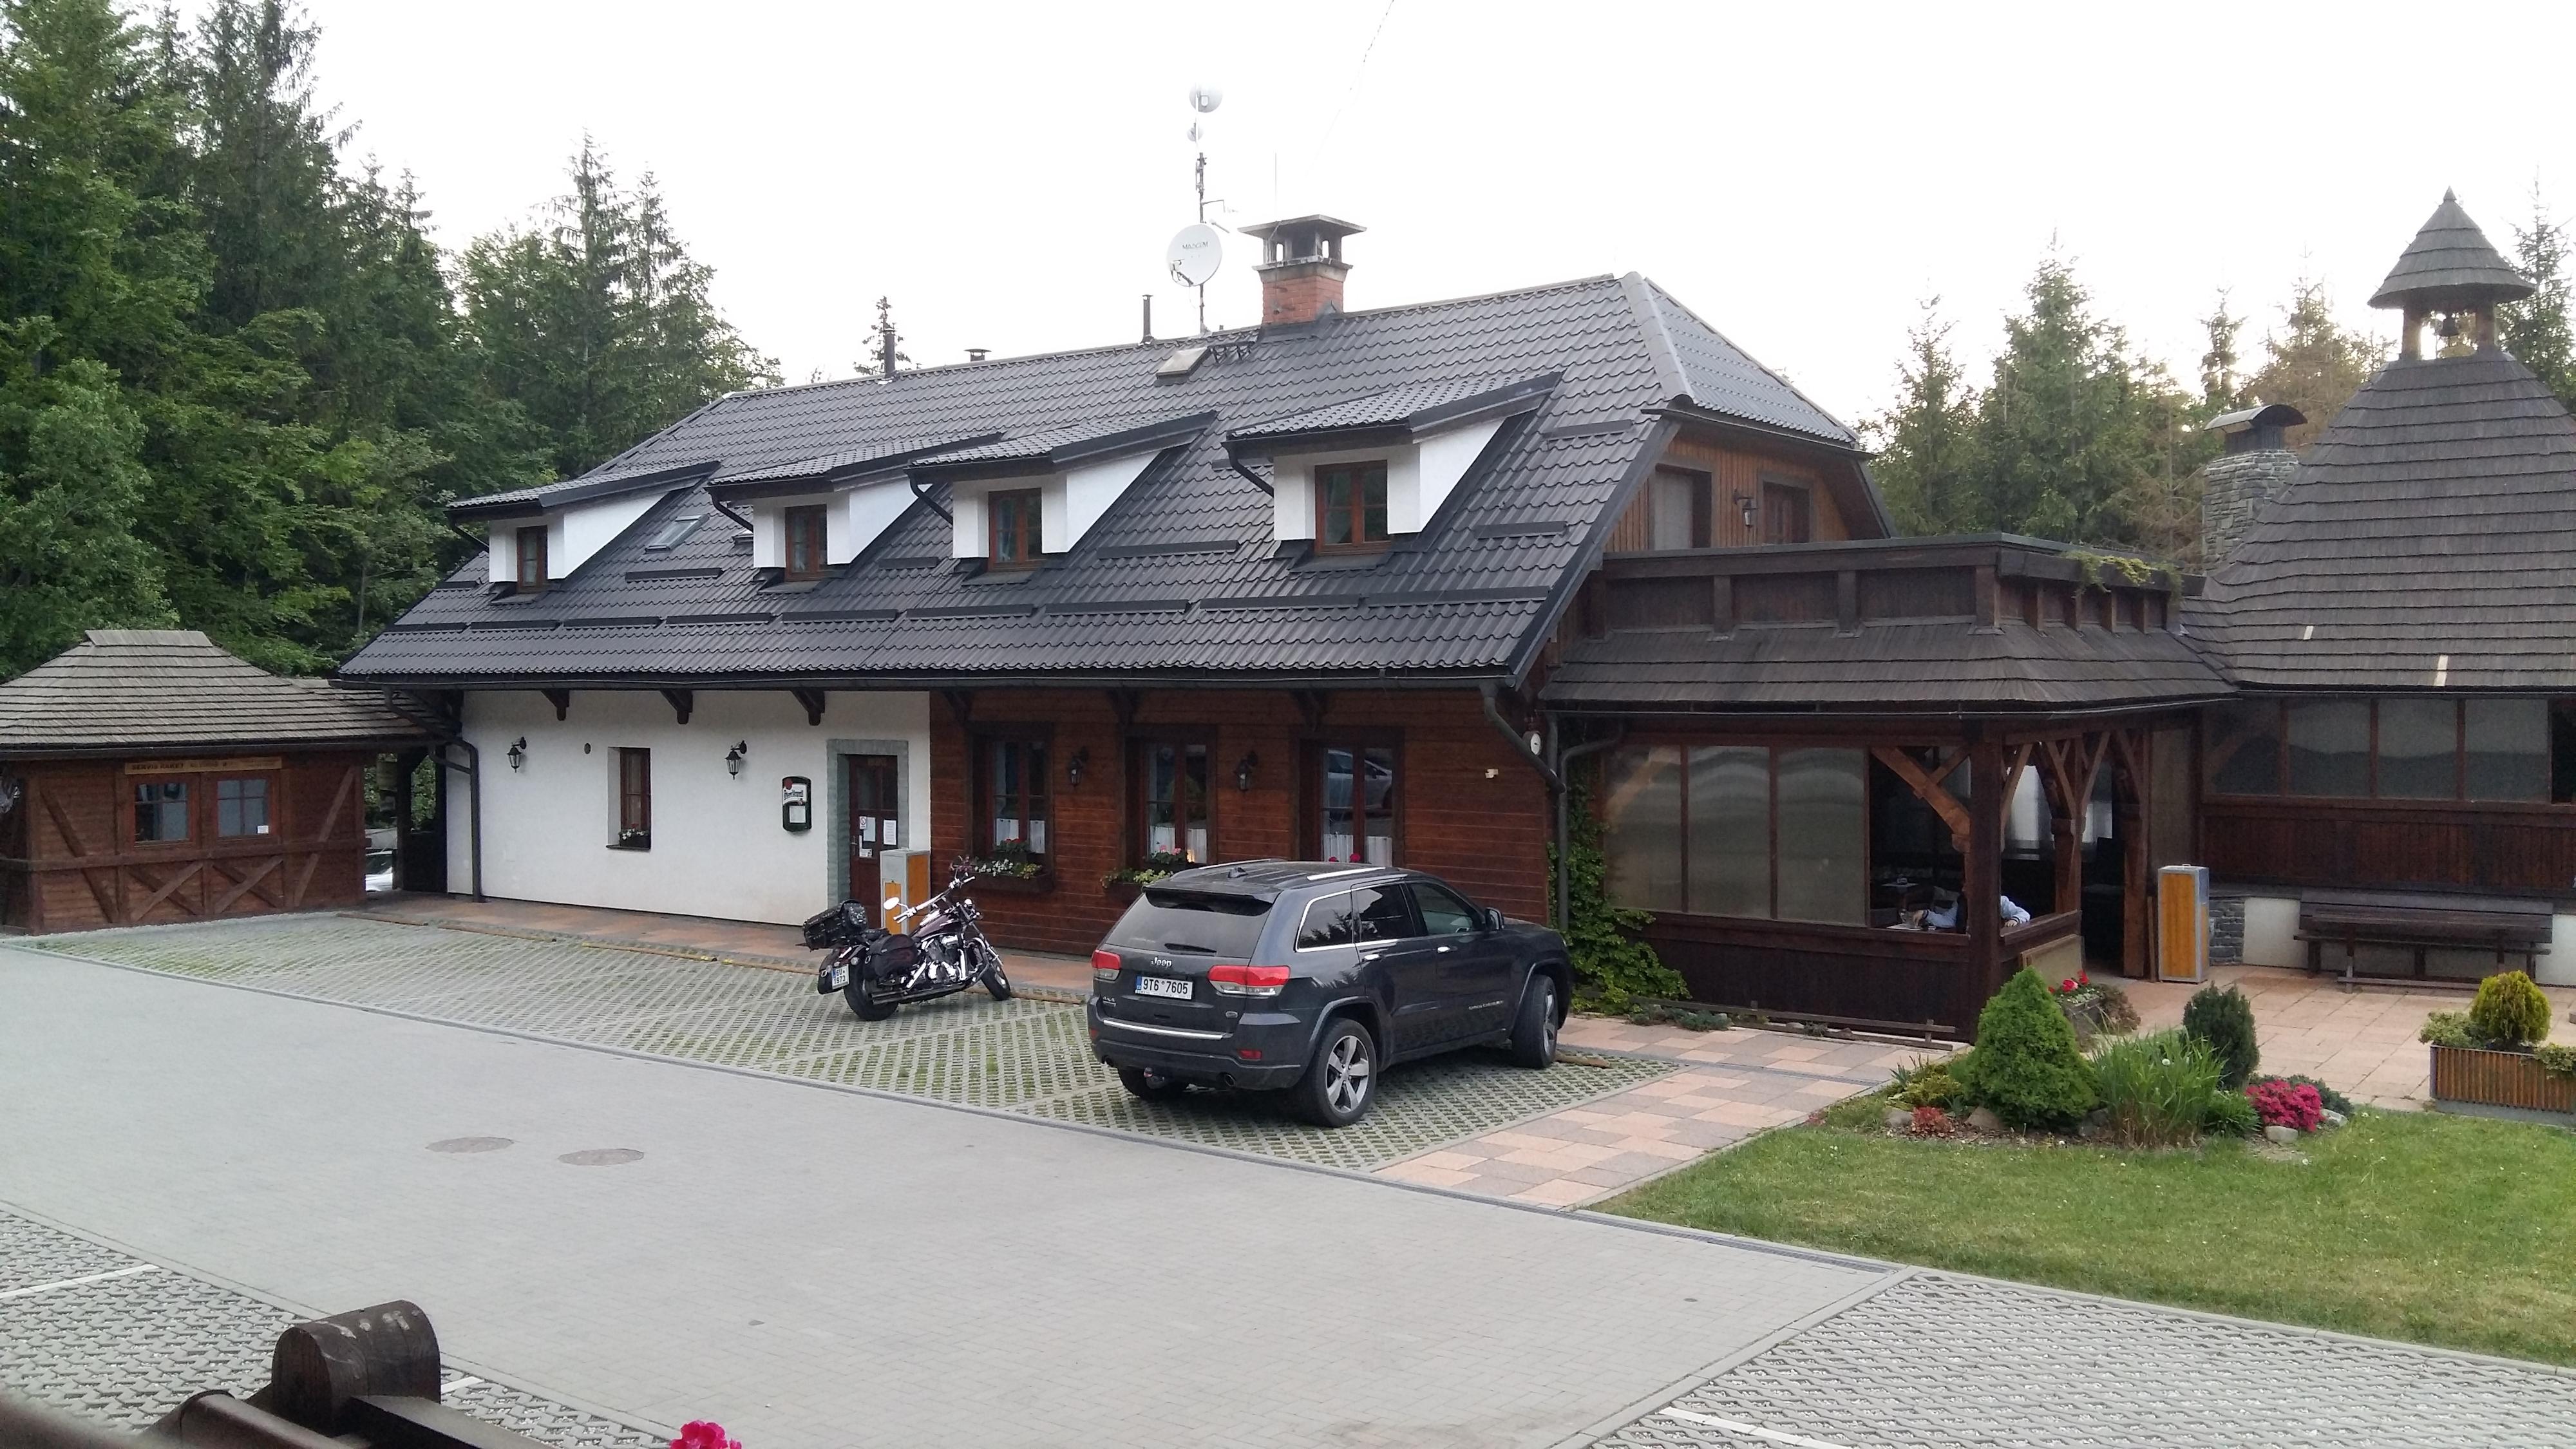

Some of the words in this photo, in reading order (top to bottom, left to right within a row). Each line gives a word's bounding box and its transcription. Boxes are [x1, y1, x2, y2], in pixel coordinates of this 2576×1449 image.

[1151, 956, 1172, 968] Jeep
[1143, 978, 1159, 991] 9T6
[1166, 981, 1189, 994] 7605
